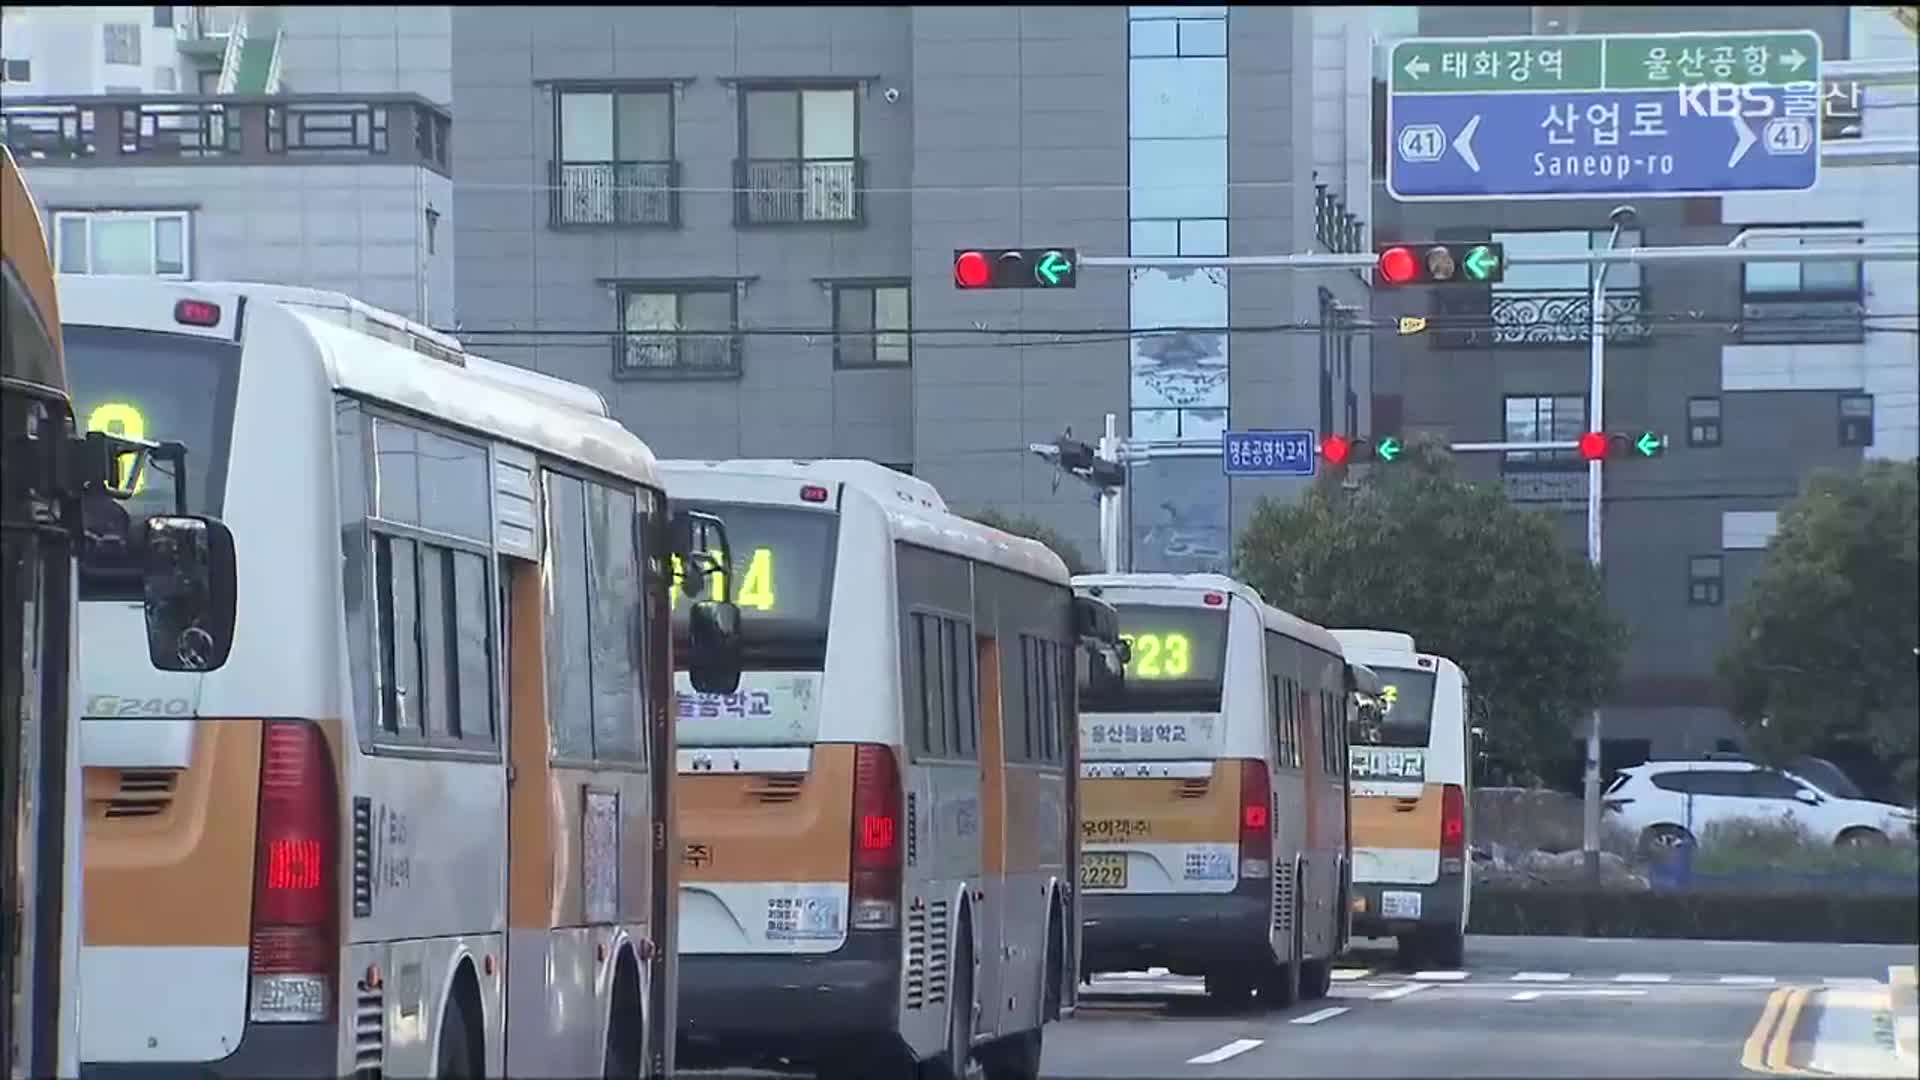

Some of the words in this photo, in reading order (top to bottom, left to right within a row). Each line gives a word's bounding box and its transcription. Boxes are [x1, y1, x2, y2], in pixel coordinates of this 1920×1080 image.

[1440, 47, 1565, 79] 태화강역
[1643, 45, 1771, 80] 울산공항
[1541, 101, 1669, 144] 산업로
[1775, 120, 1807, 150] 41
[1406, 129, 1438, 156] 41
[1533, 151, 1675, 178] Saneop-ro
[1229, 439, 1307, 466] 명촌공영차고지
[86, 697, 189, 715] G240
